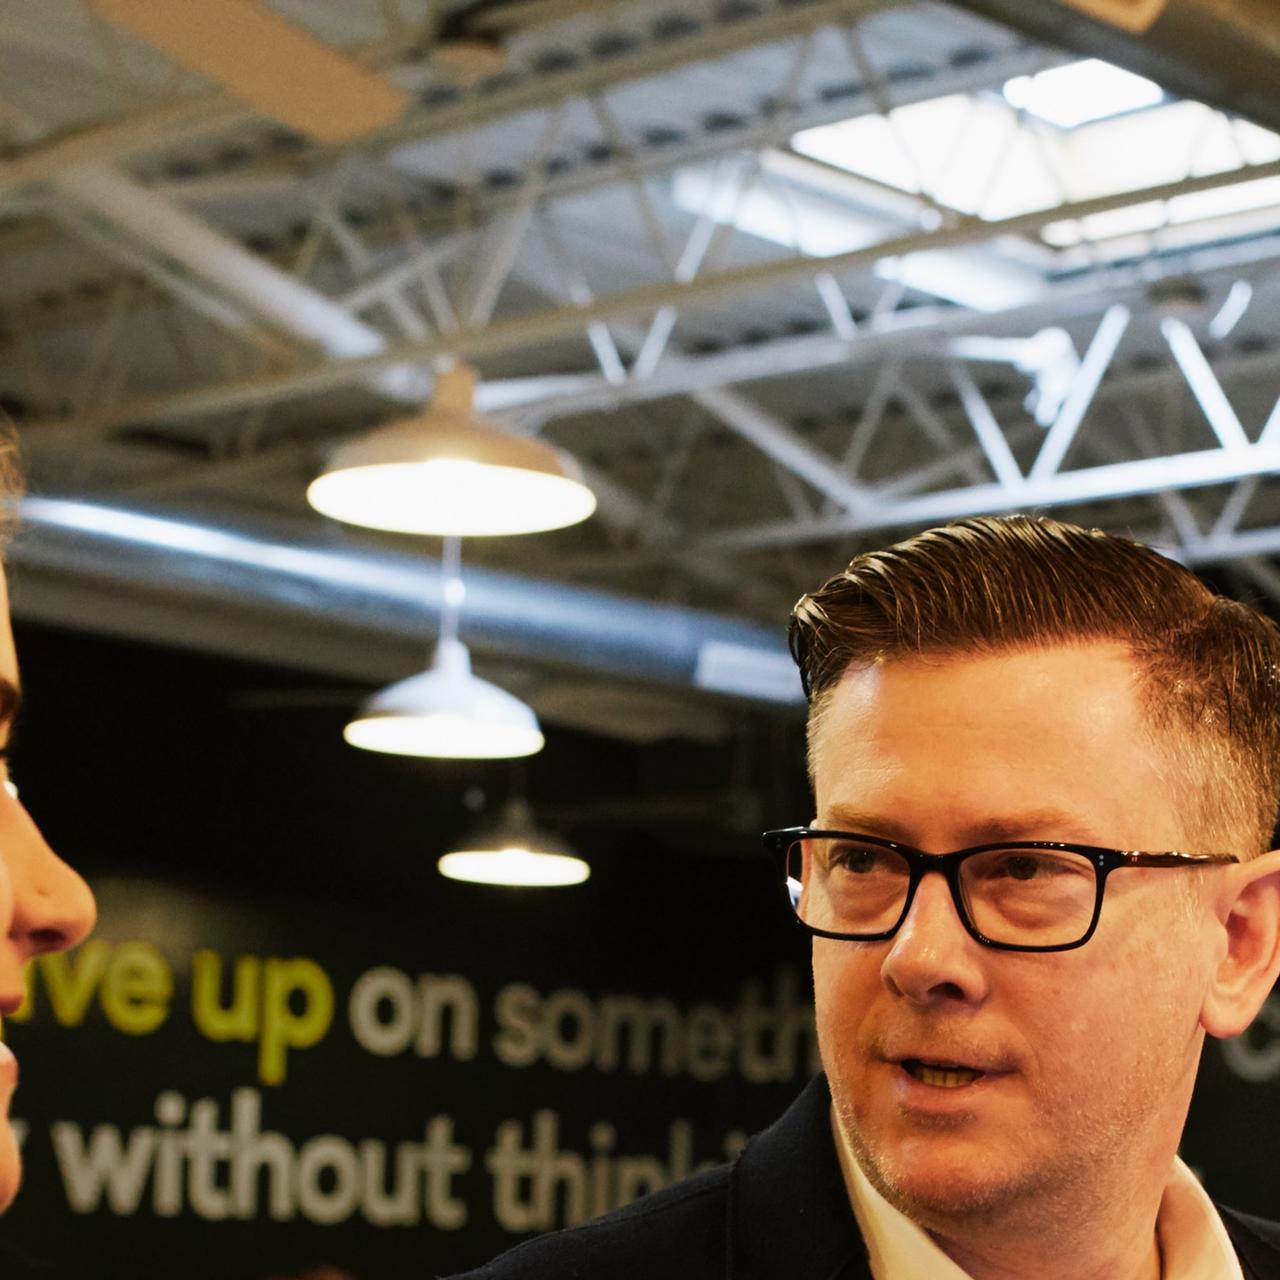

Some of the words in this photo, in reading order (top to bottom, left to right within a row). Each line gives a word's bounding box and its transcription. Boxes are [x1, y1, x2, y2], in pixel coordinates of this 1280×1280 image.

[192, 949, 333, 1085] up
[350, 967, 478, 1060] on
[494, 966, 824, 1084] someth
[51, 1088, 468, 1227] without
